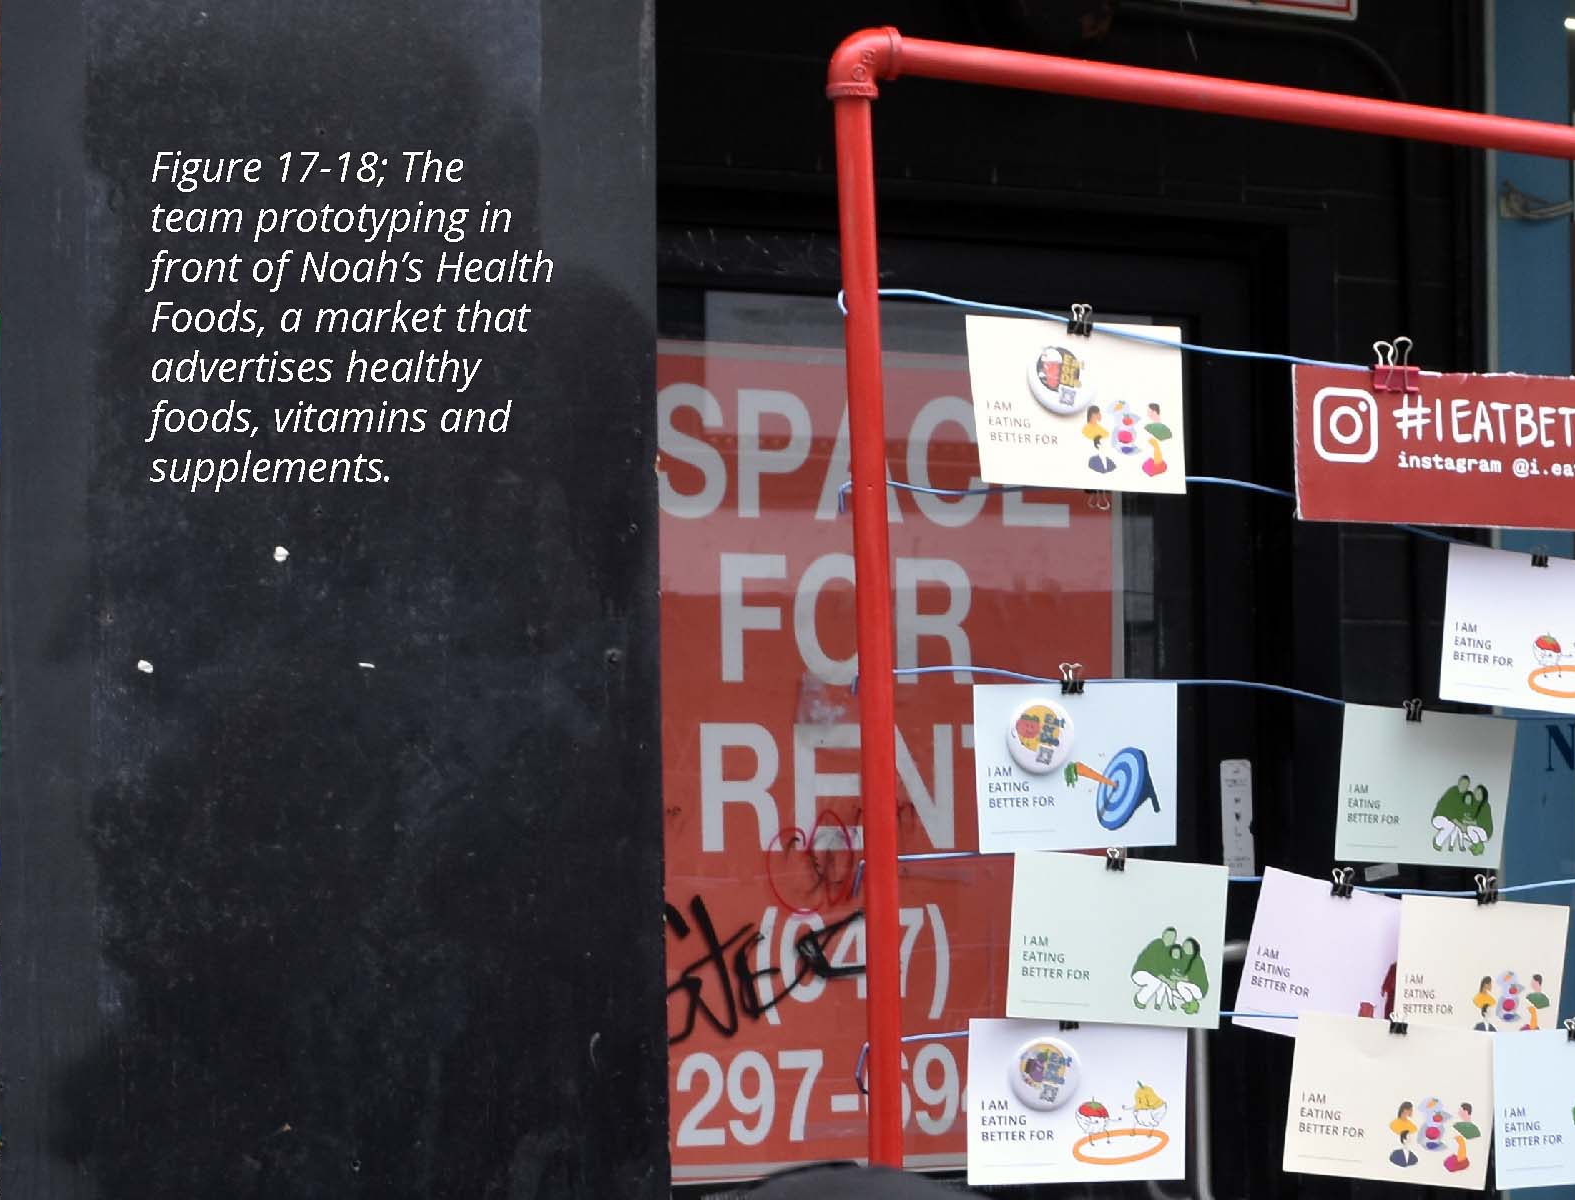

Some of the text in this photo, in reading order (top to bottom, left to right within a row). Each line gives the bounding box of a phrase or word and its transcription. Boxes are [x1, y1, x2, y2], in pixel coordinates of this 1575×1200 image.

[1398, 451, 1502, 474] instagram
[719, 551, 974, 687] FOR
[994, 767, 1012, 777] AM
[699, 722, 975, 852] REN
[989, 782, 1029, 792] EATING
[989, 797, 1054, 809] BETTER FOR
[1308, 1093, 1326, 1104] AM
[989, 1100, 1008, 1110] AM
[1300, 1107, 1341, 1121] EATING
[981, 1115, 1026, 1126] EATING
[981, 1130, 1054, 1141] BETTER FOR
[1299, 1122, 1364, 1138] BETTER FOR
